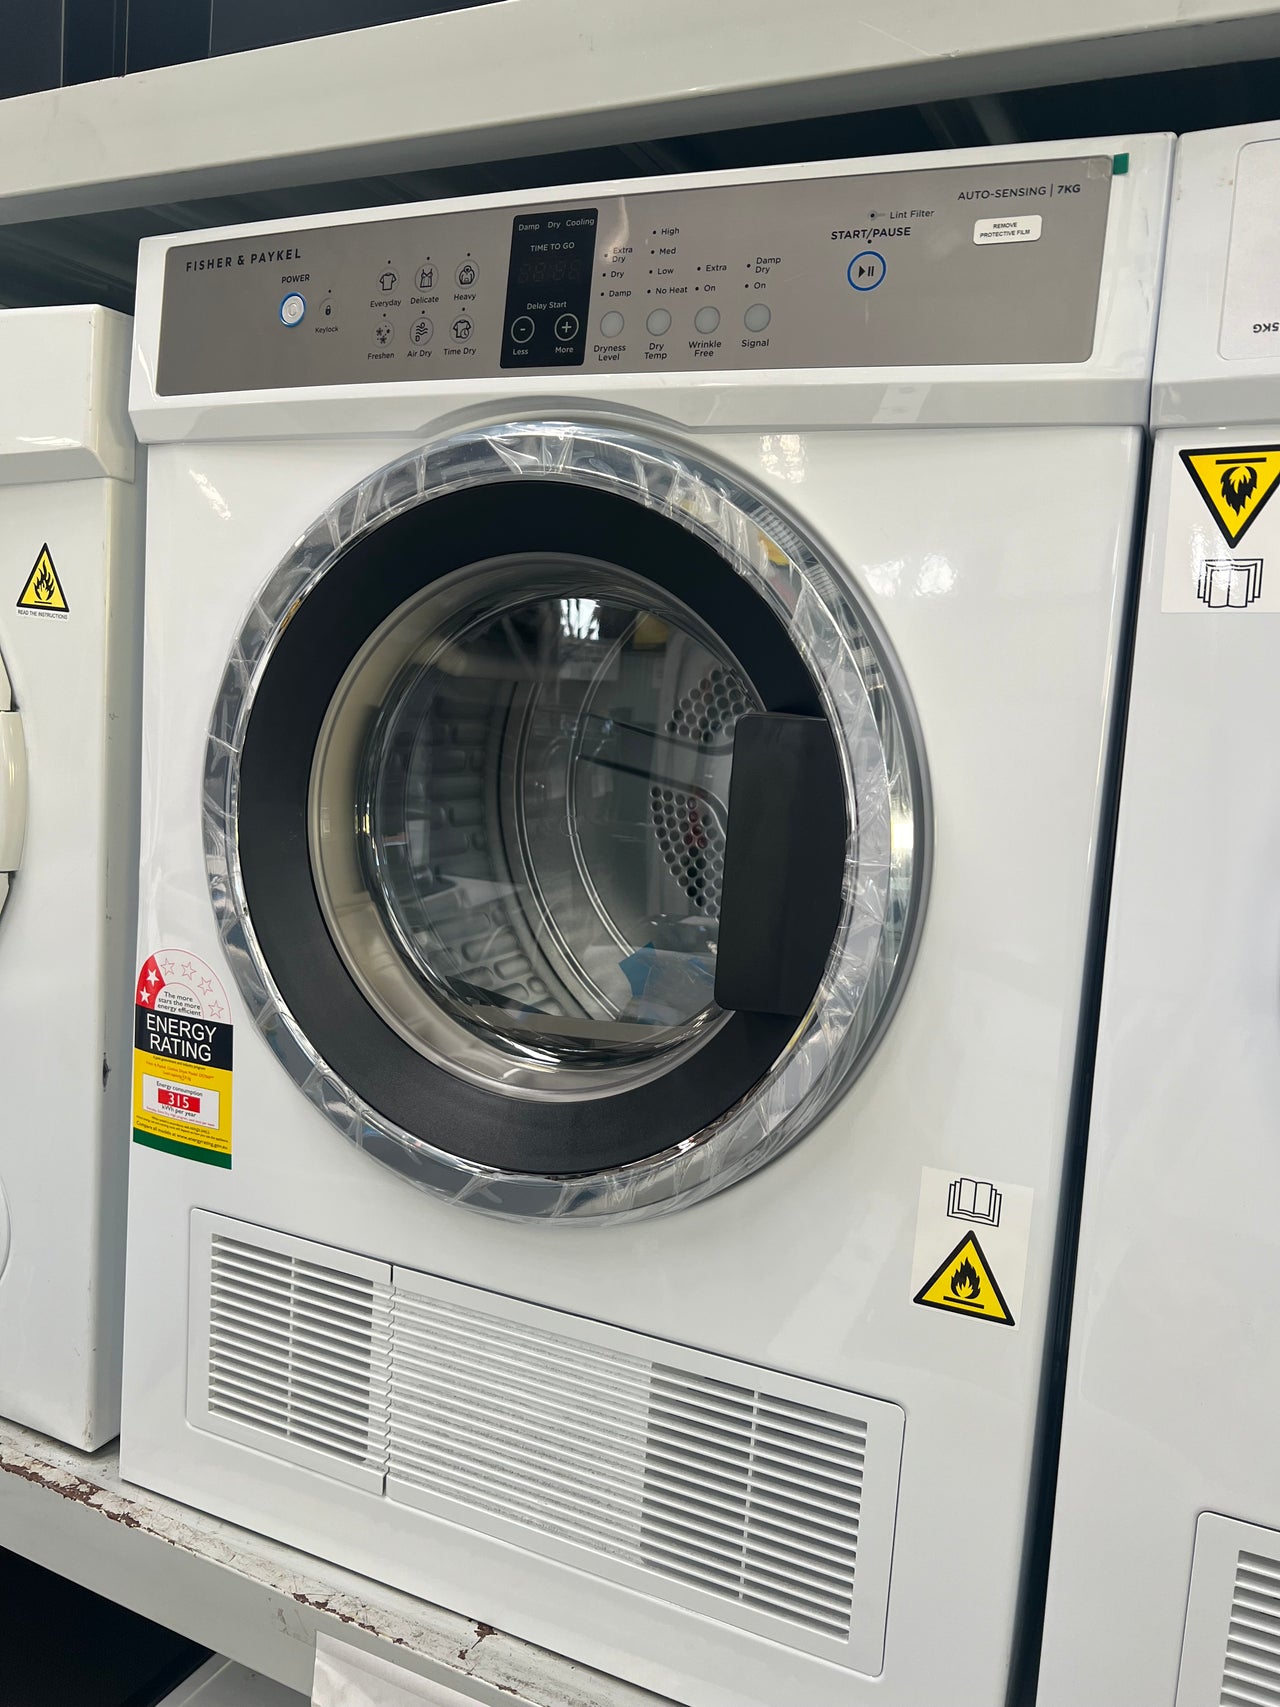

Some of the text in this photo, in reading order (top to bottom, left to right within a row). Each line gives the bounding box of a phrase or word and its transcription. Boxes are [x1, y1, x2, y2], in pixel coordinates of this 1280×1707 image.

[957, 183, 1082, 201] AUTO-SENSING 7KG
[889, 208, 935, 220] Lint Filter
[518, 217, 595, 233] Damp Dry Cooling
[993, 221, 1018, 230] REMOVE
[661, 226, 680, 236] High
[831, 226, 911, 240] START/PAUSE
[980, 228, 1031, 239] PROTECTIVE FILM
[530, 241, 575, 252] TIME TO GO
[612, 246, 634, 255] Extra
[659, 246, 676, 255] Med
[186, 248, 302, 272] FISHER & PAYKEL
[612, 254, 626, 264] Dry
[756, 256, 782, 267] Damp
[657, 266, 674, 275] Low
[705, 263, 727, 272] Extra
[755, 265, 771, 275] Dry
[281, 273, 311, 283] POWER
[610, 270, 625, 279] Dry
[655, 285, 688, 295] No Heat
[704, 283, 716, 292] On
[753, 281, 766, 290] On
[454, 292, 477, 302] Heavy
[608, 288, 632, 299] Damp
[370, 298, 402, 308] Everyday
[410, 295, 440, 305] Delicate
[526, 300, 567, 311] Delay Start
[315, 324, 339, 334] Keylock
[593, 343, 627, 353] Dryness
[649, 342, 665, 351] Dry
[688, 339, 722, 349] Wrinkle
[741, 338, 770, 349] Signal
[407, 349, 433, 359] Air Dry
[443, 346, 477, 356] Time Dry
[512, 347, 529, 356] Less
[555, 345, 574, 354] More
[694, 348, 714, 358] Free
[367, 351, 395, 361] Freshen
[598, 352, 620, 362] Level
[644, 351, 668, 361] Temp
[38, 611, 68, 620] INSTRUCTIONS
[164, 990, 193, 1002] The more
[158, 997, 201, 1011] stars the more
[157, 1003, 201, 1017] energy efficient
[146, 1013, 217, 1043] ENERGY
[150, 1035, 212, 1062] RATING
[156, 1080, 203, 1097] Energy consumption
[168, 1092, 190, 1109] 315
[161, 1103, 174, 1112] kWh
[185, 1110, 197, 1118] year
